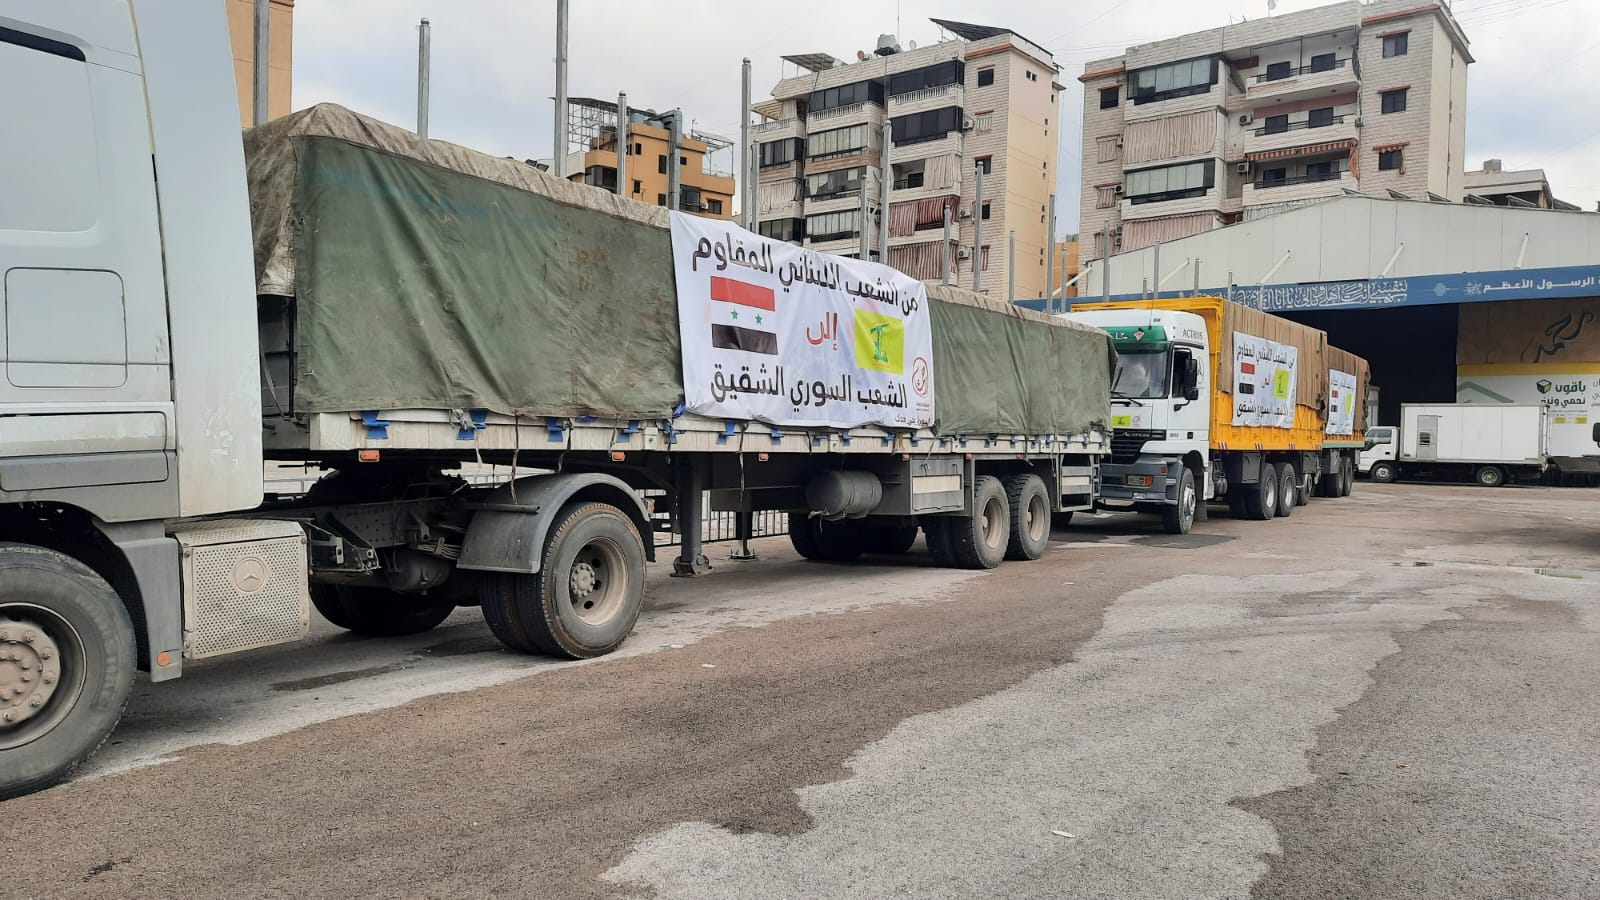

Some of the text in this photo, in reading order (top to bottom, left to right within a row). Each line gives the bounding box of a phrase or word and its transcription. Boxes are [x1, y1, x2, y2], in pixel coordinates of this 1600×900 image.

[692, 231, 918, 317] من الشعب اللبناني المقاوم
[1483, 279, 1533, 294] الأعظم
[1537, 276, 1595, 290] الرسول
[806, 311, 839, 351] إلى
[710, 360, 785, 403] الشقيق
[790, 373, 852, 414] السوري
[857, 376, 908, 413] الشعب
[1555, 380, 1586, 395] باقون
[1561, 396, 1586, 408] نحمي
